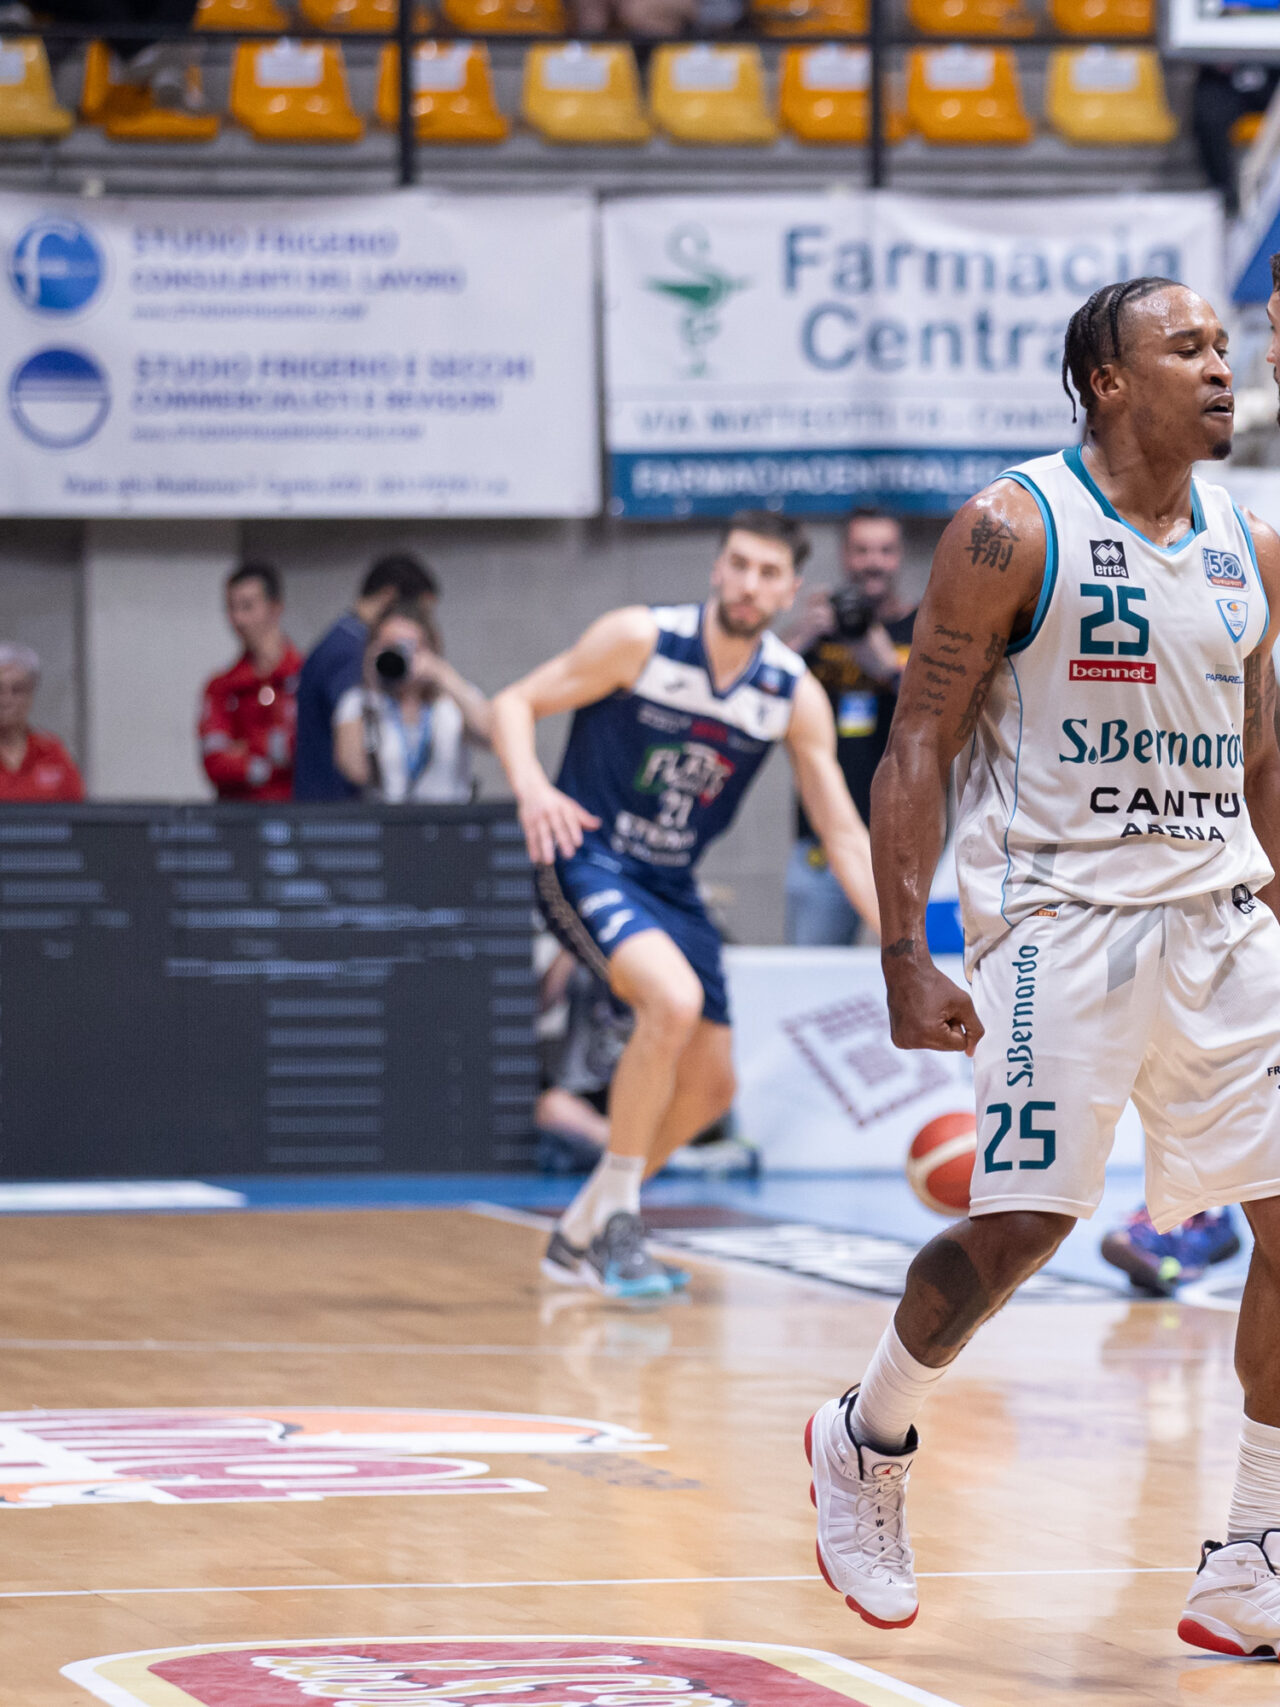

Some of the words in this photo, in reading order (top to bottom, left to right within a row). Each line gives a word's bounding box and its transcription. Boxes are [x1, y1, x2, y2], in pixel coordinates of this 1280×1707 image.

[782, 222, 1182, 294] Farmacia
[800, 301, 1068, 373] Centra
[1079, 582, 1150, 657] 25
[1072, 663, 1154, 681] bennet
[1119, 822, 1226, 843] ARENA
[1006, 944, 1040, 1088] S.Bernardo
[984, 1100, 1057, 1174] 25
